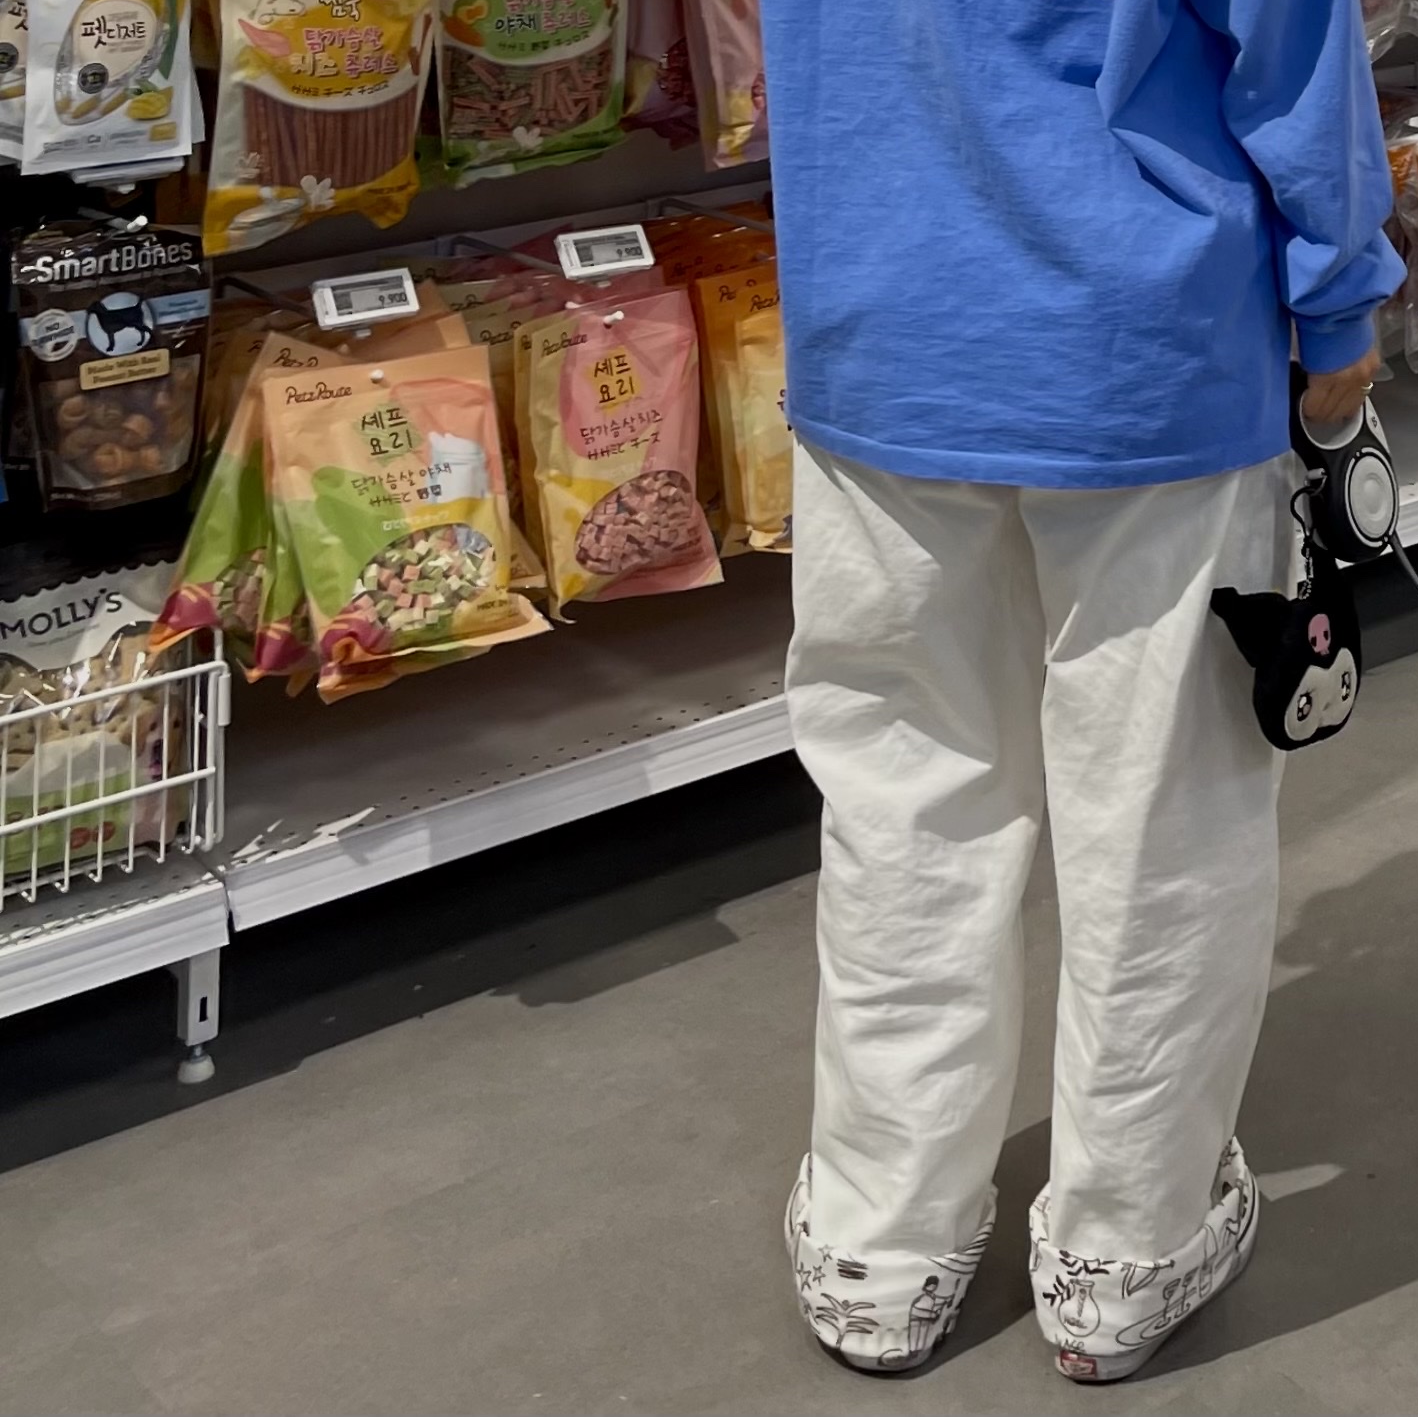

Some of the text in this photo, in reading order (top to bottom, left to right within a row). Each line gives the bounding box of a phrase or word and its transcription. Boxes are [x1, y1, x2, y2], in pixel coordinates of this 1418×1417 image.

[495, 13, 537, 34] 야채
[35, 242, 193, 283] SmartBones
[599, 376, 635, 403] 요리
[370, 429, 413, 456] 요리
[580, 417, 636, 445] 닭가슴살
[351, 462, 452, 497] 닭가슴살 야채
[0, 588, 122, 640] MOLLY'S
